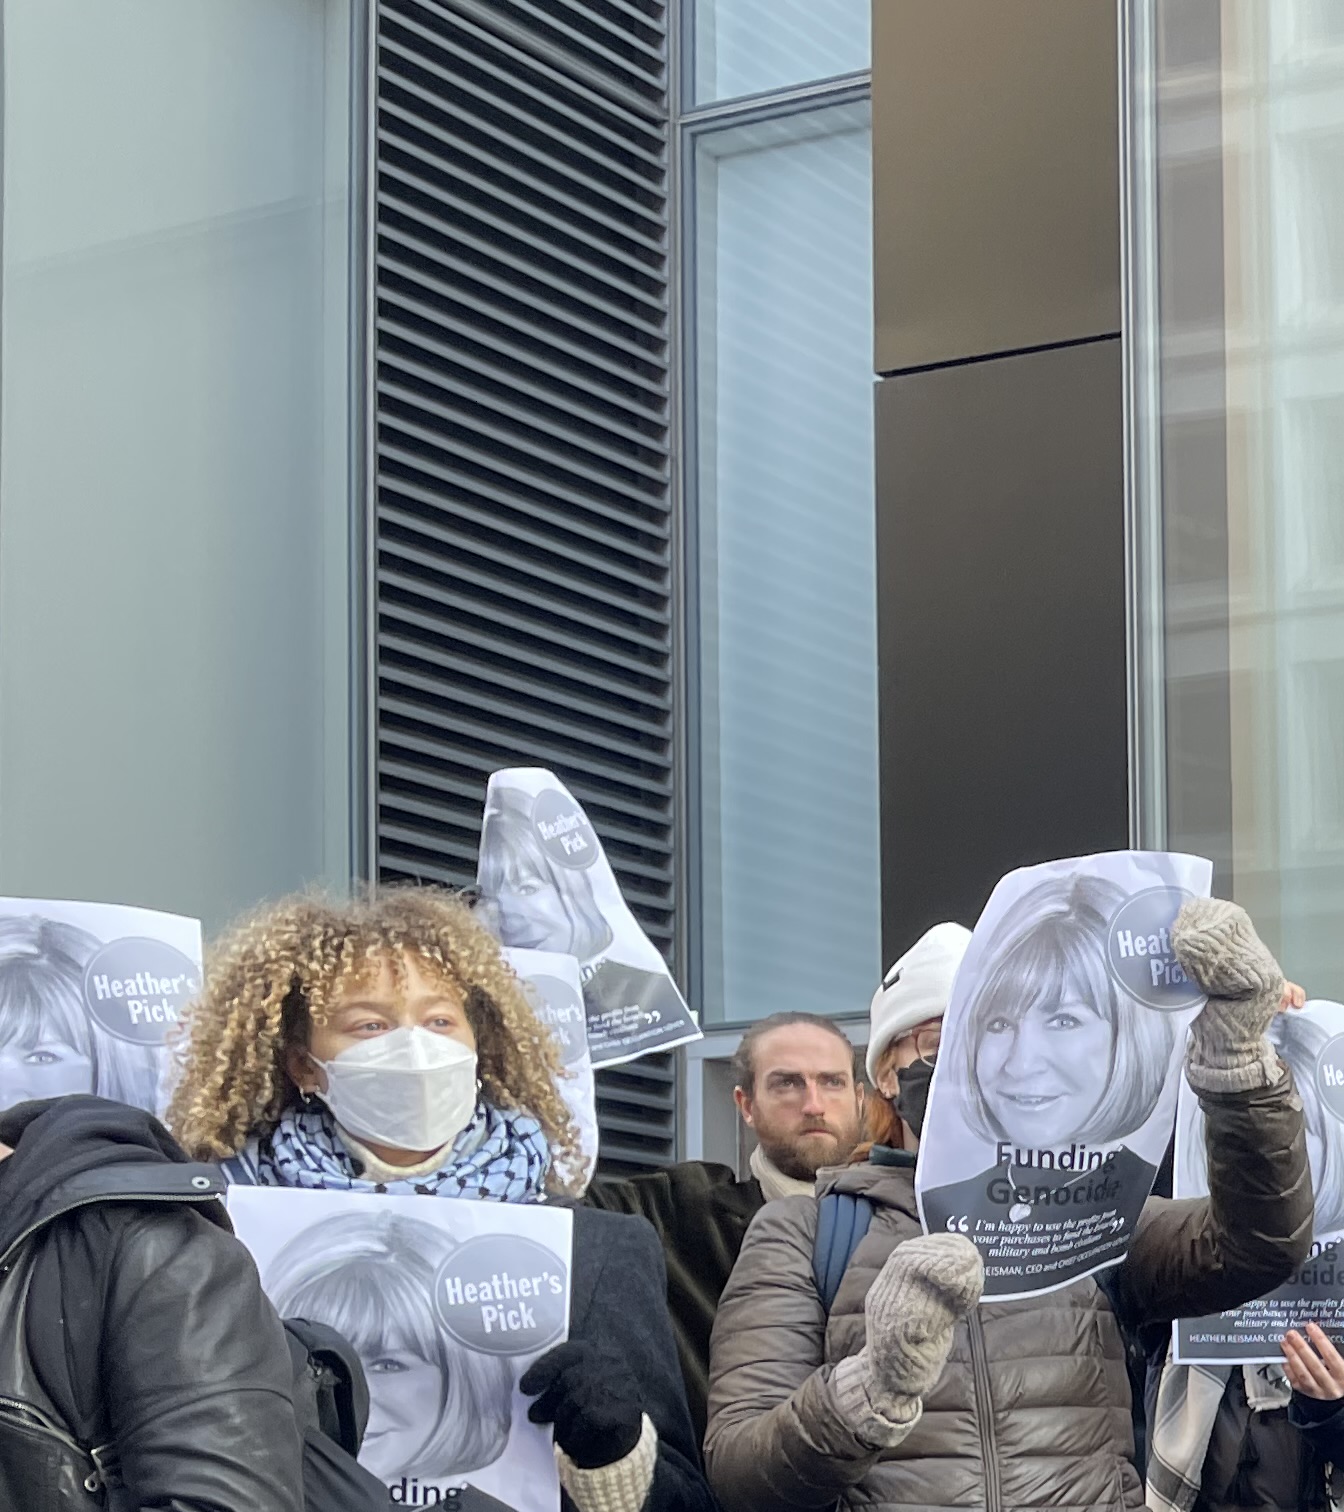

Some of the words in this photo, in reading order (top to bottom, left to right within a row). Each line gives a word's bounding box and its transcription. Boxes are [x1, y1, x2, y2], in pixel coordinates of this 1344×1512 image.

[93, 972, 197, 1000] Heather's
[128, 998, 178, 1025] Pick
[996, 1142, 1119, 1175] Funding
[986, 1175, 1121, 1206] Genocide
[975, 1219, 995, 1231] I'm
[998, 1220, 1031, 1235] happy
[1033, 1222, 1044, 1232] to
[973, 1234, 1000, 1245] your
[999, 1233, 1052, 1247] purchases
[988, 1245, 1031, 1260] military
[1031, 1243, 1051, 1256] and
[983, 1264, 1023, 1277] EISMAN,
[1025, 1262, 1043, 1275] CEO
[444, 1271, 564, 1306] Heather's
[1243, 1299, 1269, 1310] appy
[1268, 1300, 1279, 1308] to
[1280, 1300, 1296, 1308] use
[1297, 1297, 1311, 1308] the
[1311, 1297, 1339, 1310] profits
[481, 1301, 537, 1334] Pick
[1220, 1310, 1243, 1320] your
[1243, 1308, 1288, 1320] purchases
[1299, 1308, 1319, 1320] fund
[1319, 1306, 1333, 1318] the
[1233, 1318, 1270, 1330] military
[1270, 1319, 1289, 1328] and
[1189, 1333, 1227, 1344] HEATHER
[1227, 1334, 1267, 1345] REISMAN,
[1267, 1333, 1286, 1343] CEO
[388, 1477, 464, 1512] ding
